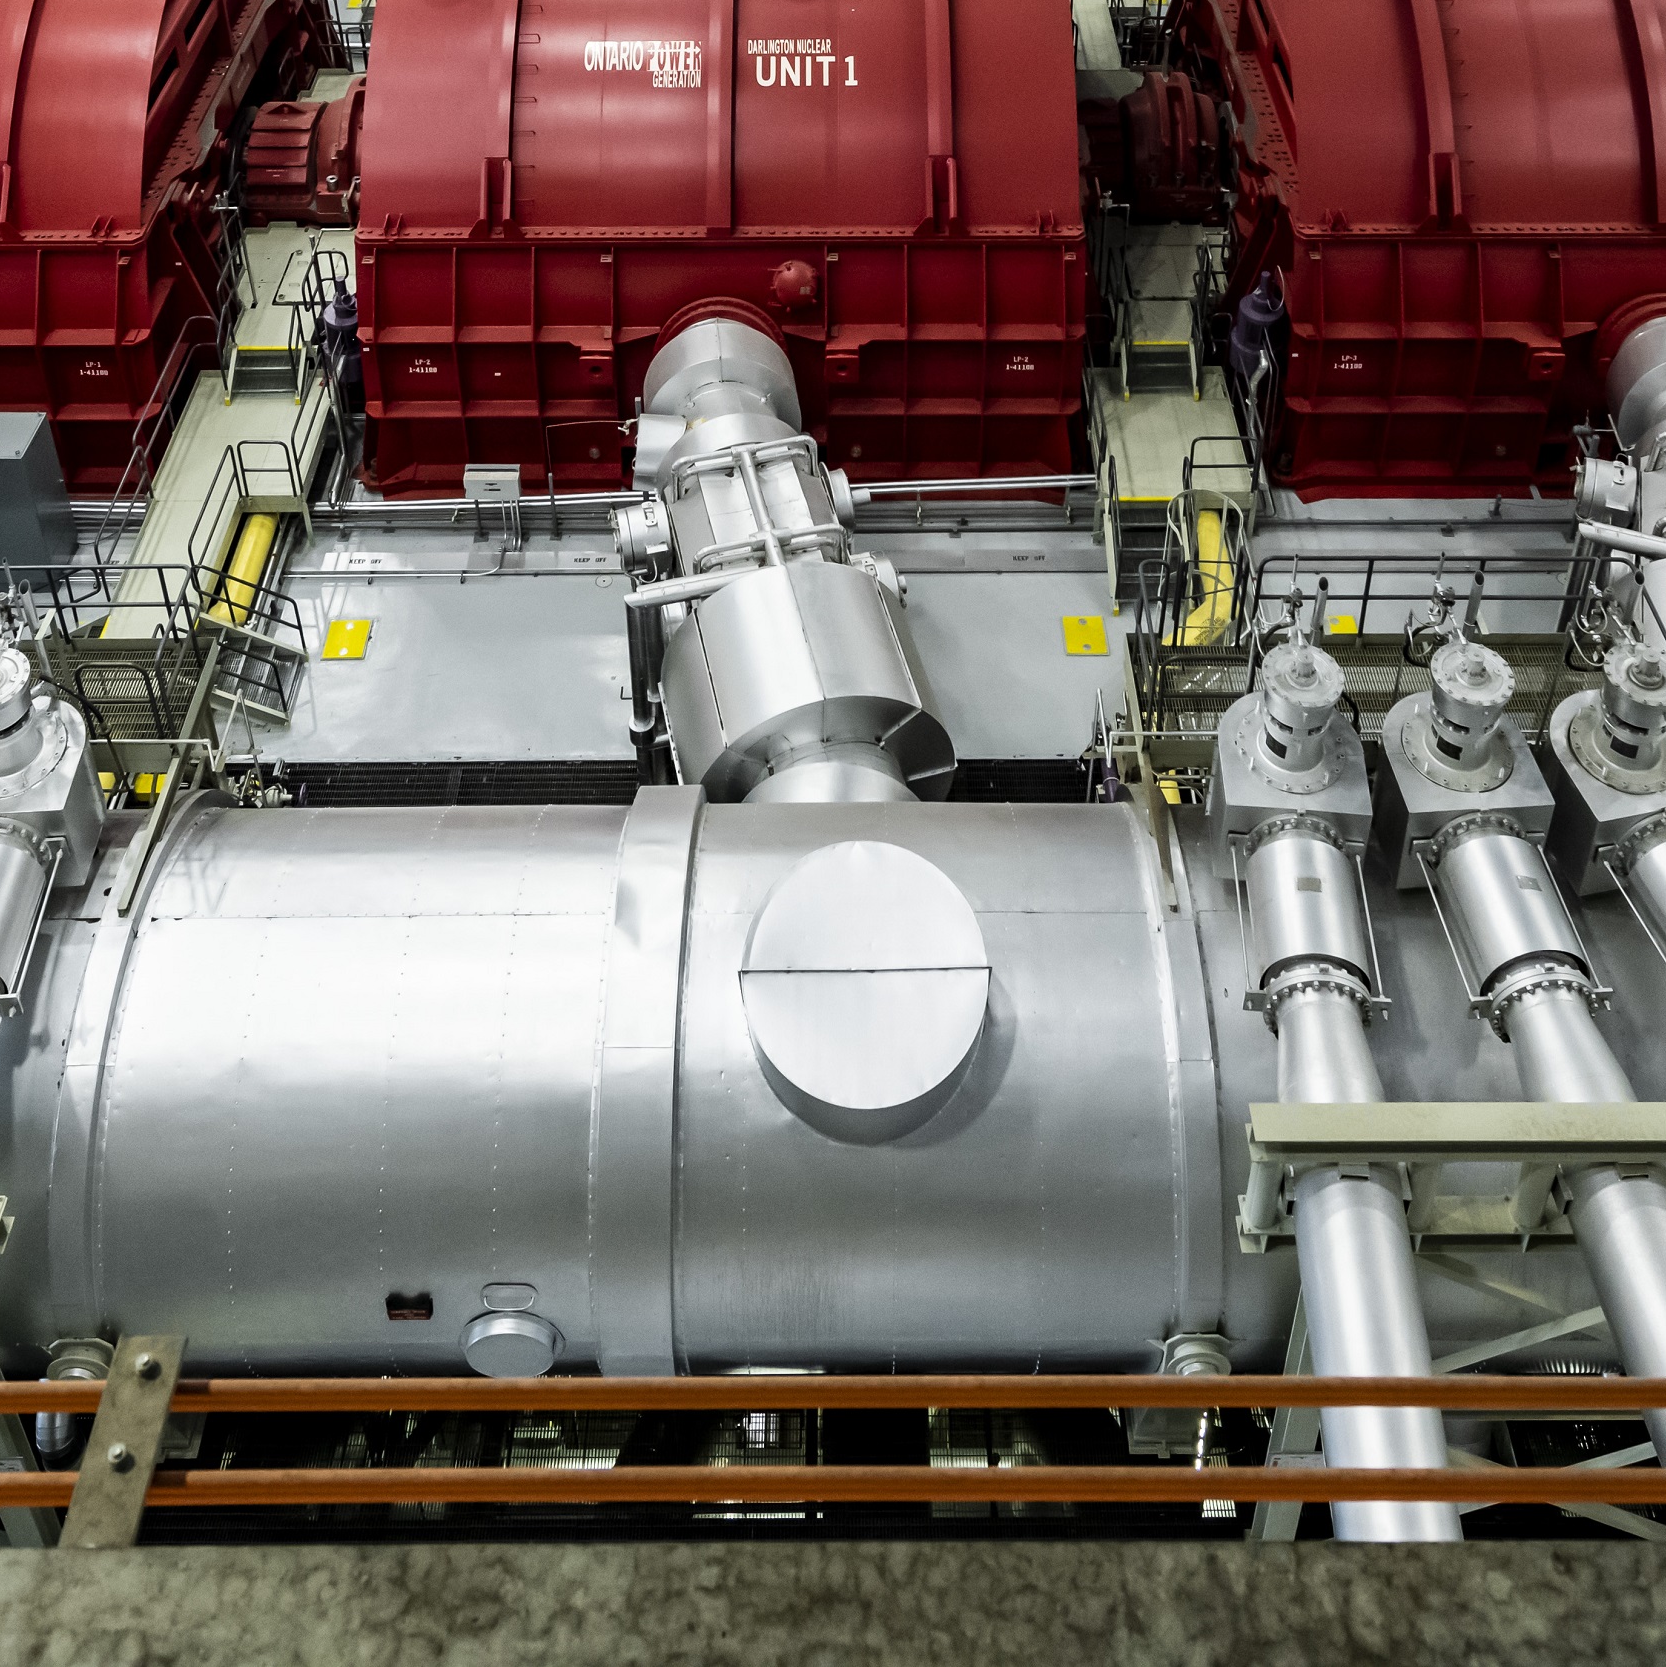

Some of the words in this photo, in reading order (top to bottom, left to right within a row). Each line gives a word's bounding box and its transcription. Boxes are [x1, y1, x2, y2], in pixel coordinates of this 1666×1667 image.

[584, 40, 644, 72] ONTARIO
[647, 41, 702, 72] POWER
[747, 39, 795, 54] DARLINGTON
[797, 38, 832, 54] NUCLEAR
[653, 71, 702, 88] GENERATION
[756, 56, 836, 87] UNIT
[844, 55, 859, 86] 1
